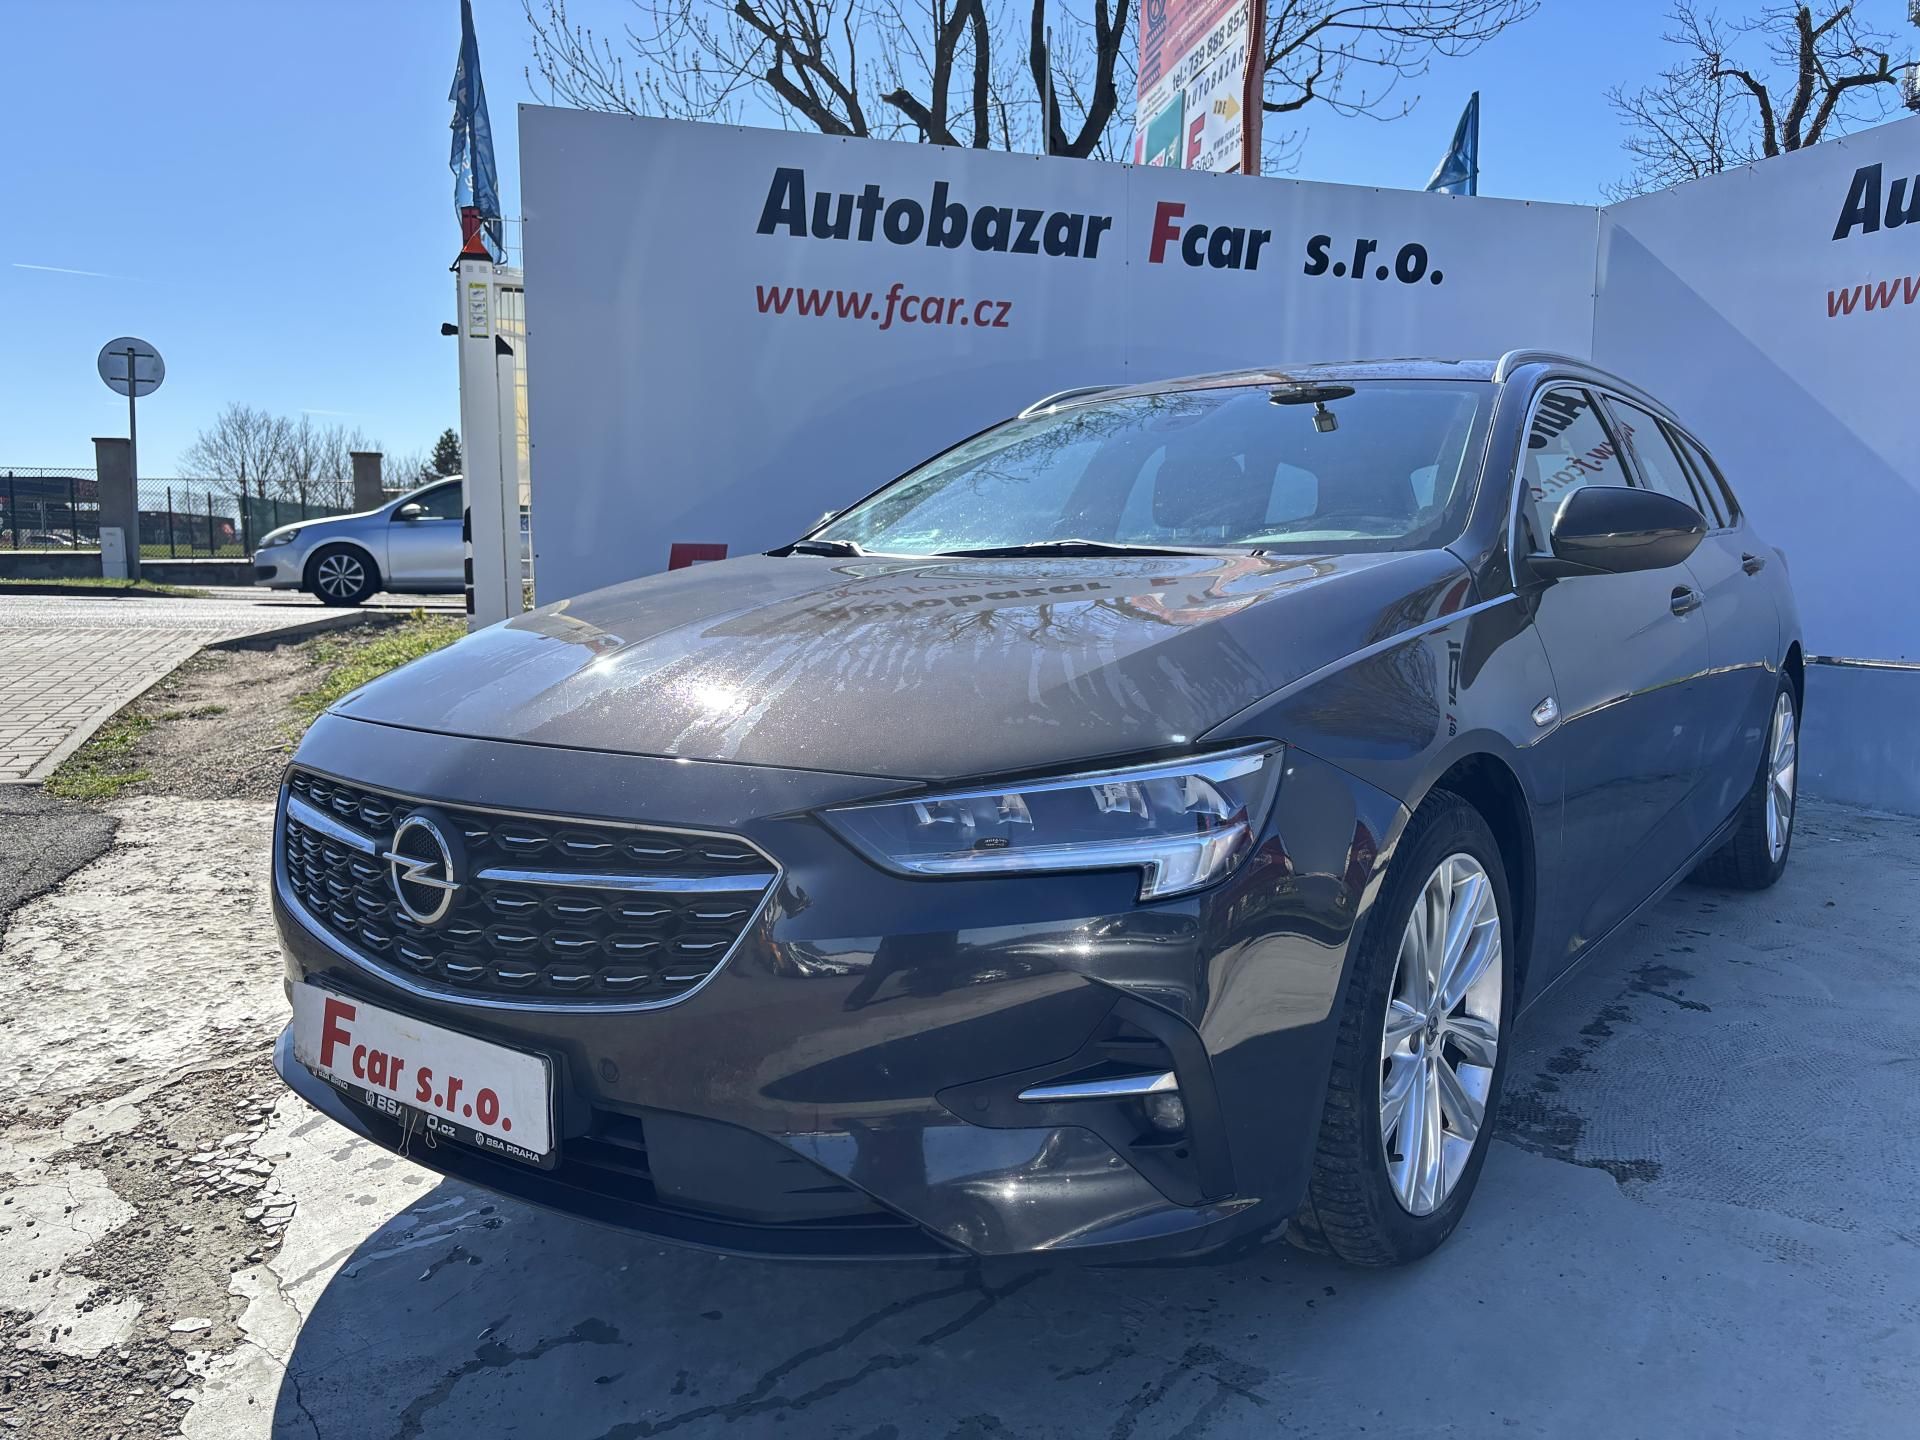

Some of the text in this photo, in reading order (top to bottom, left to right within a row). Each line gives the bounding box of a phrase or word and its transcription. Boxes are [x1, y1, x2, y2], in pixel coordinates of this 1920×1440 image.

[1172, 64, 1188, 92] tel.:
[1188, 45, 1205, 77] 739
[1206, 25, 1225, 59] 888
[1185, 45, 1245, 113] AUTOBAZAR
[756, 167, 1444, 286] Autobazar Fcar s.r.o.
[755, 283, 1013, 330] www.fcar.cz
[319, 997, 513, 1132] Fcar s.r.o.
[486, 1137, 540, 1163] BSA PRAHA
